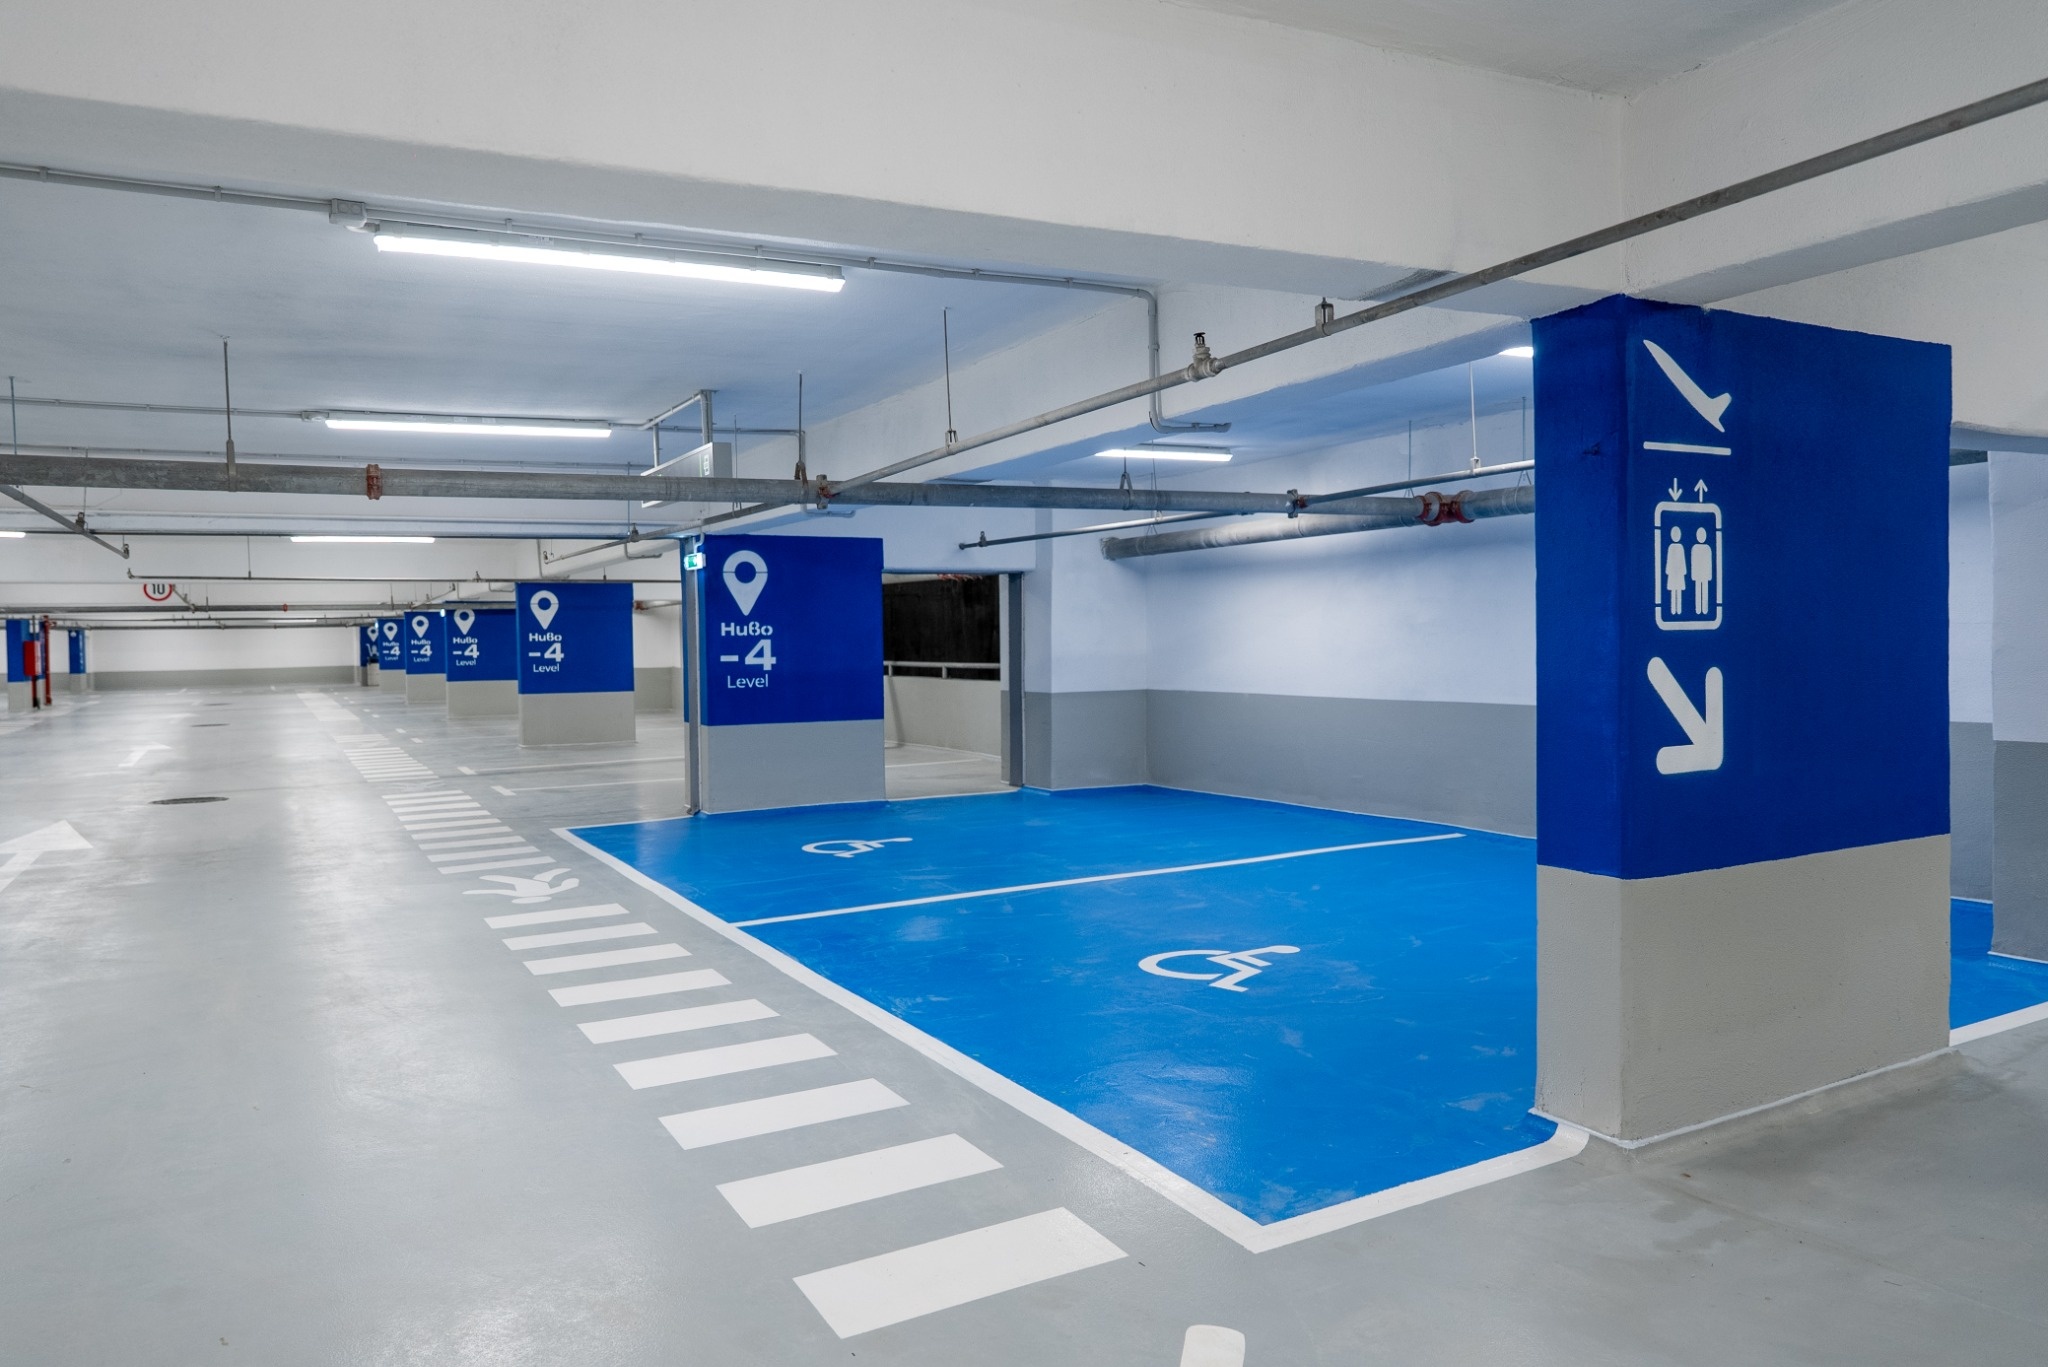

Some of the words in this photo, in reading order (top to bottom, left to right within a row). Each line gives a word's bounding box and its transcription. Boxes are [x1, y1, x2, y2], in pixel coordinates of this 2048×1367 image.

[452, 644, 480, 659] -4
[528, 642, 565, 662] -4
[720, 639, 777, 671] -4
[533, 663, 560, 673] Level
[727, 673, 769, 689] Level
